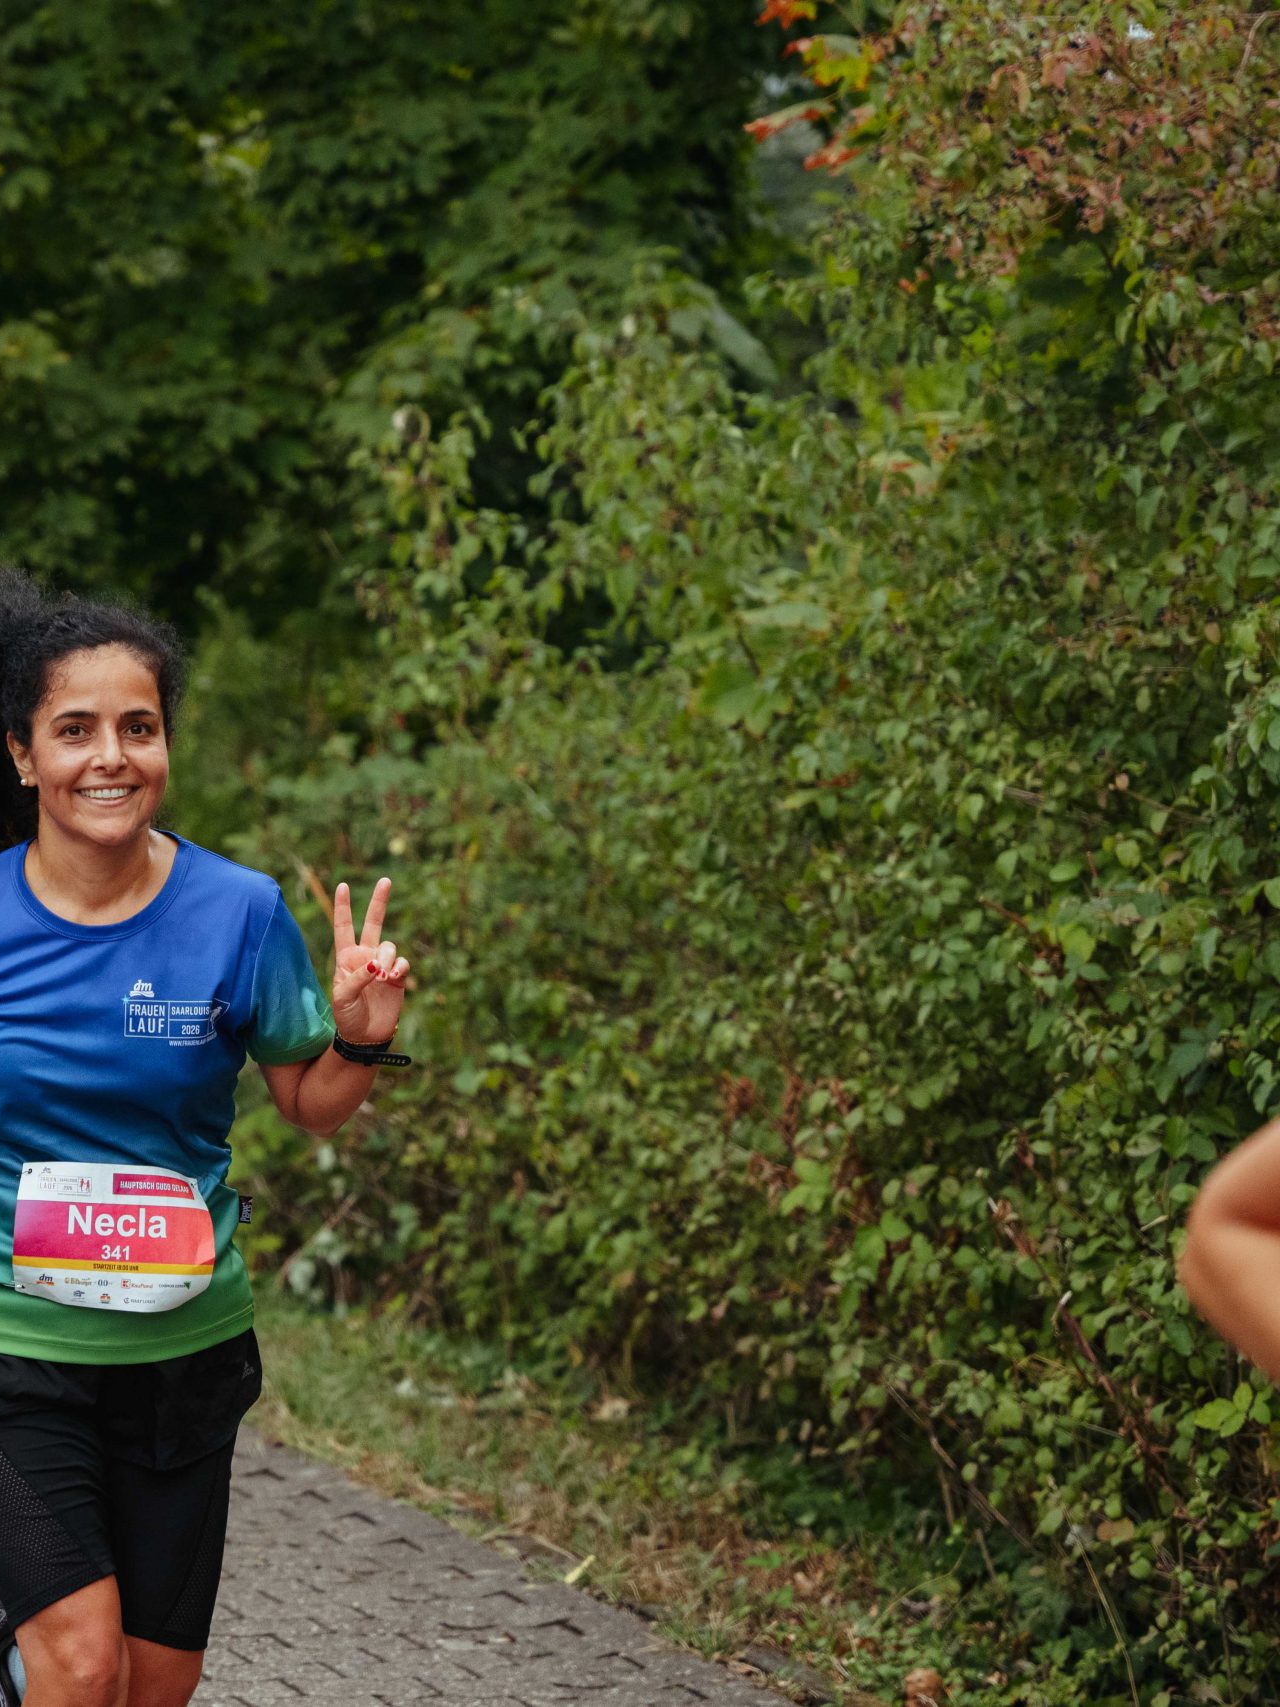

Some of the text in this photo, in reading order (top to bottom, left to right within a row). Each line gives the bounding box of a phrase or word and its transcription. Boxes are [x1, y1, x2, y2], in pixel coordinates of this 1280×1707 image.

[133, 979, 152, 992] dm
[129, 1004, 166, 1017] FRAUEN
[171, 1006, 210, 1016] SAARLOUIS
[128, 1018, 166, 1033] LAUF
[120, 1181, 155, 1190] HAUPTSACH
[67, 1204, 167, 1239] Necla
[101, 1245, 130, 1261] 341
[39, 1273, 53, 1282] dm
